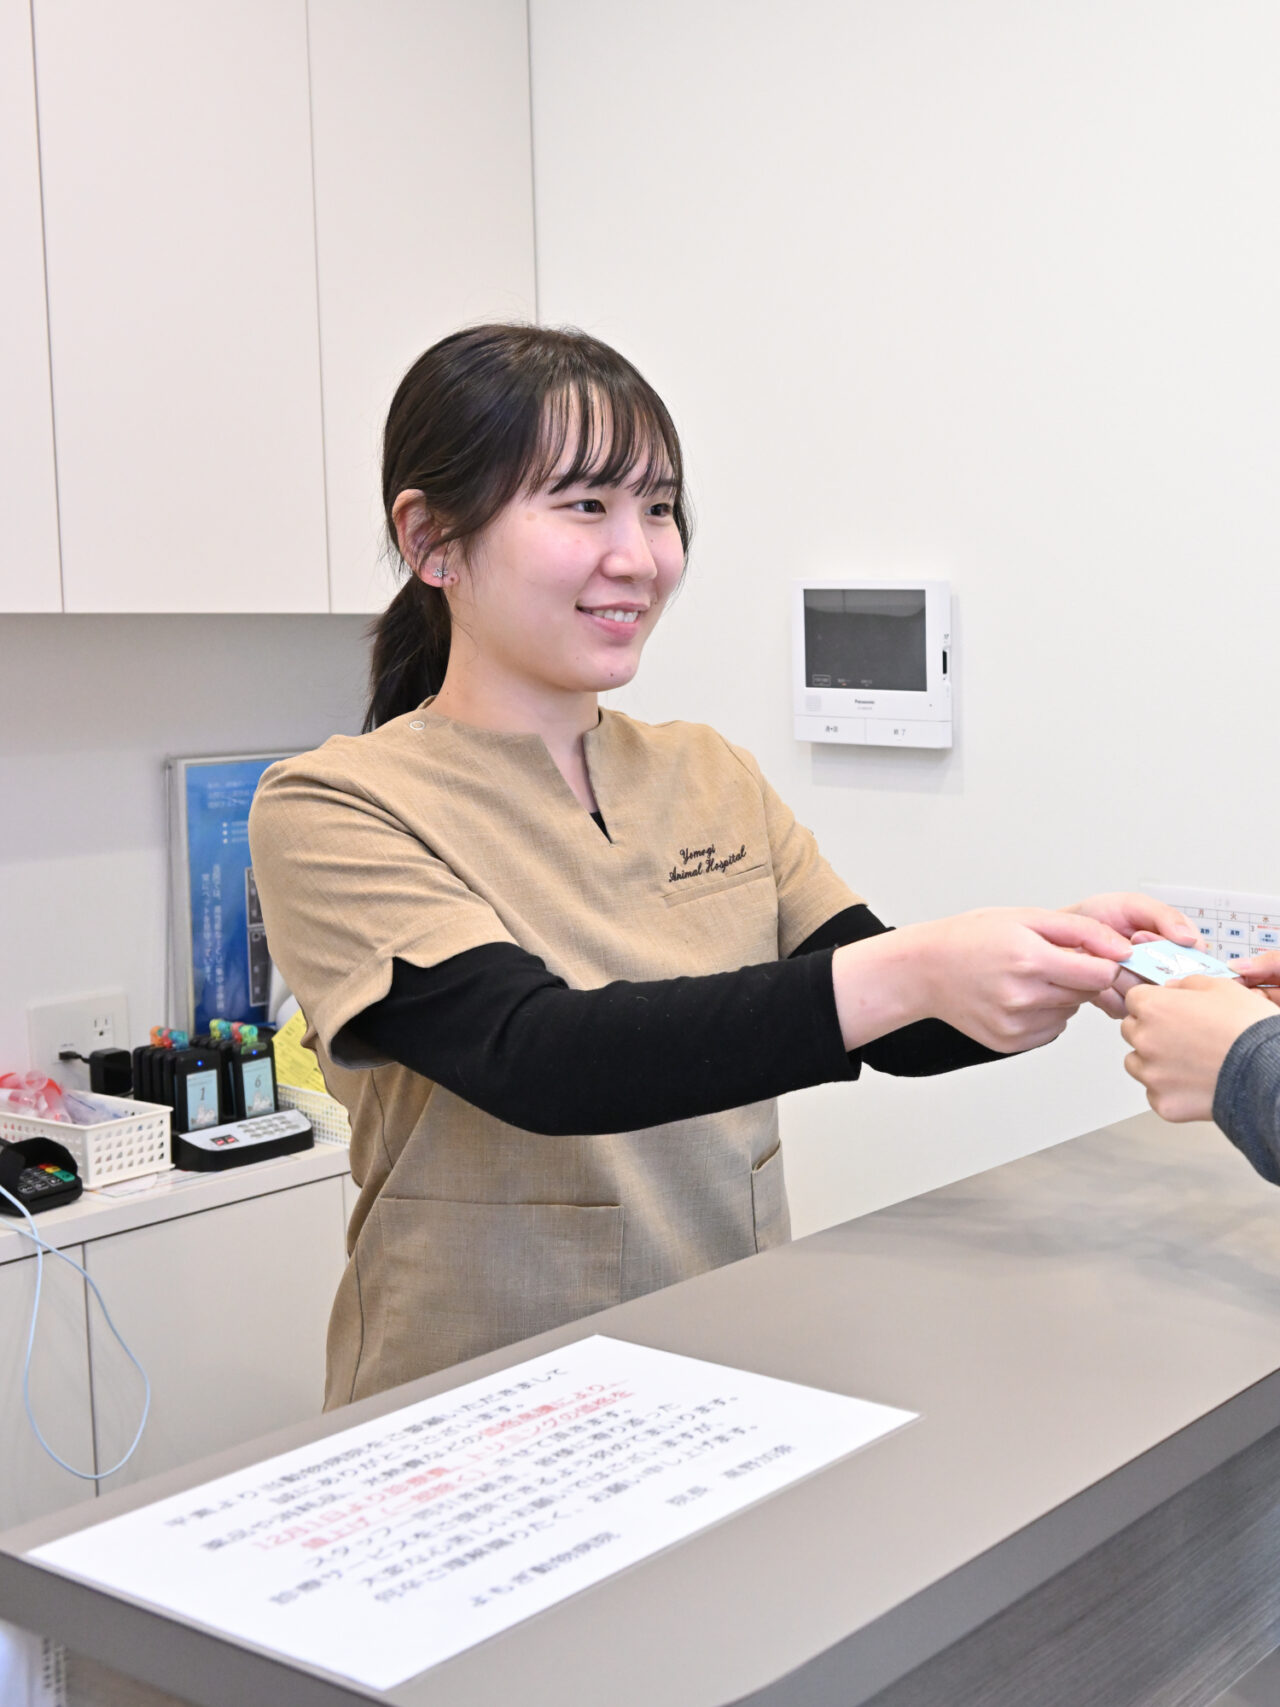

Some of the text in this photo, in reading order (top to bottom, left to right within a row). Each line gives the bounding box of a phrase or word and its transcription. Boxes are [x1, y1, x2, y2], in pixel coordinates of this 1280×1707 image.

[668, 845, 747, 882] Animal Hospital
[680, 844, 716, 864] Yomogi
